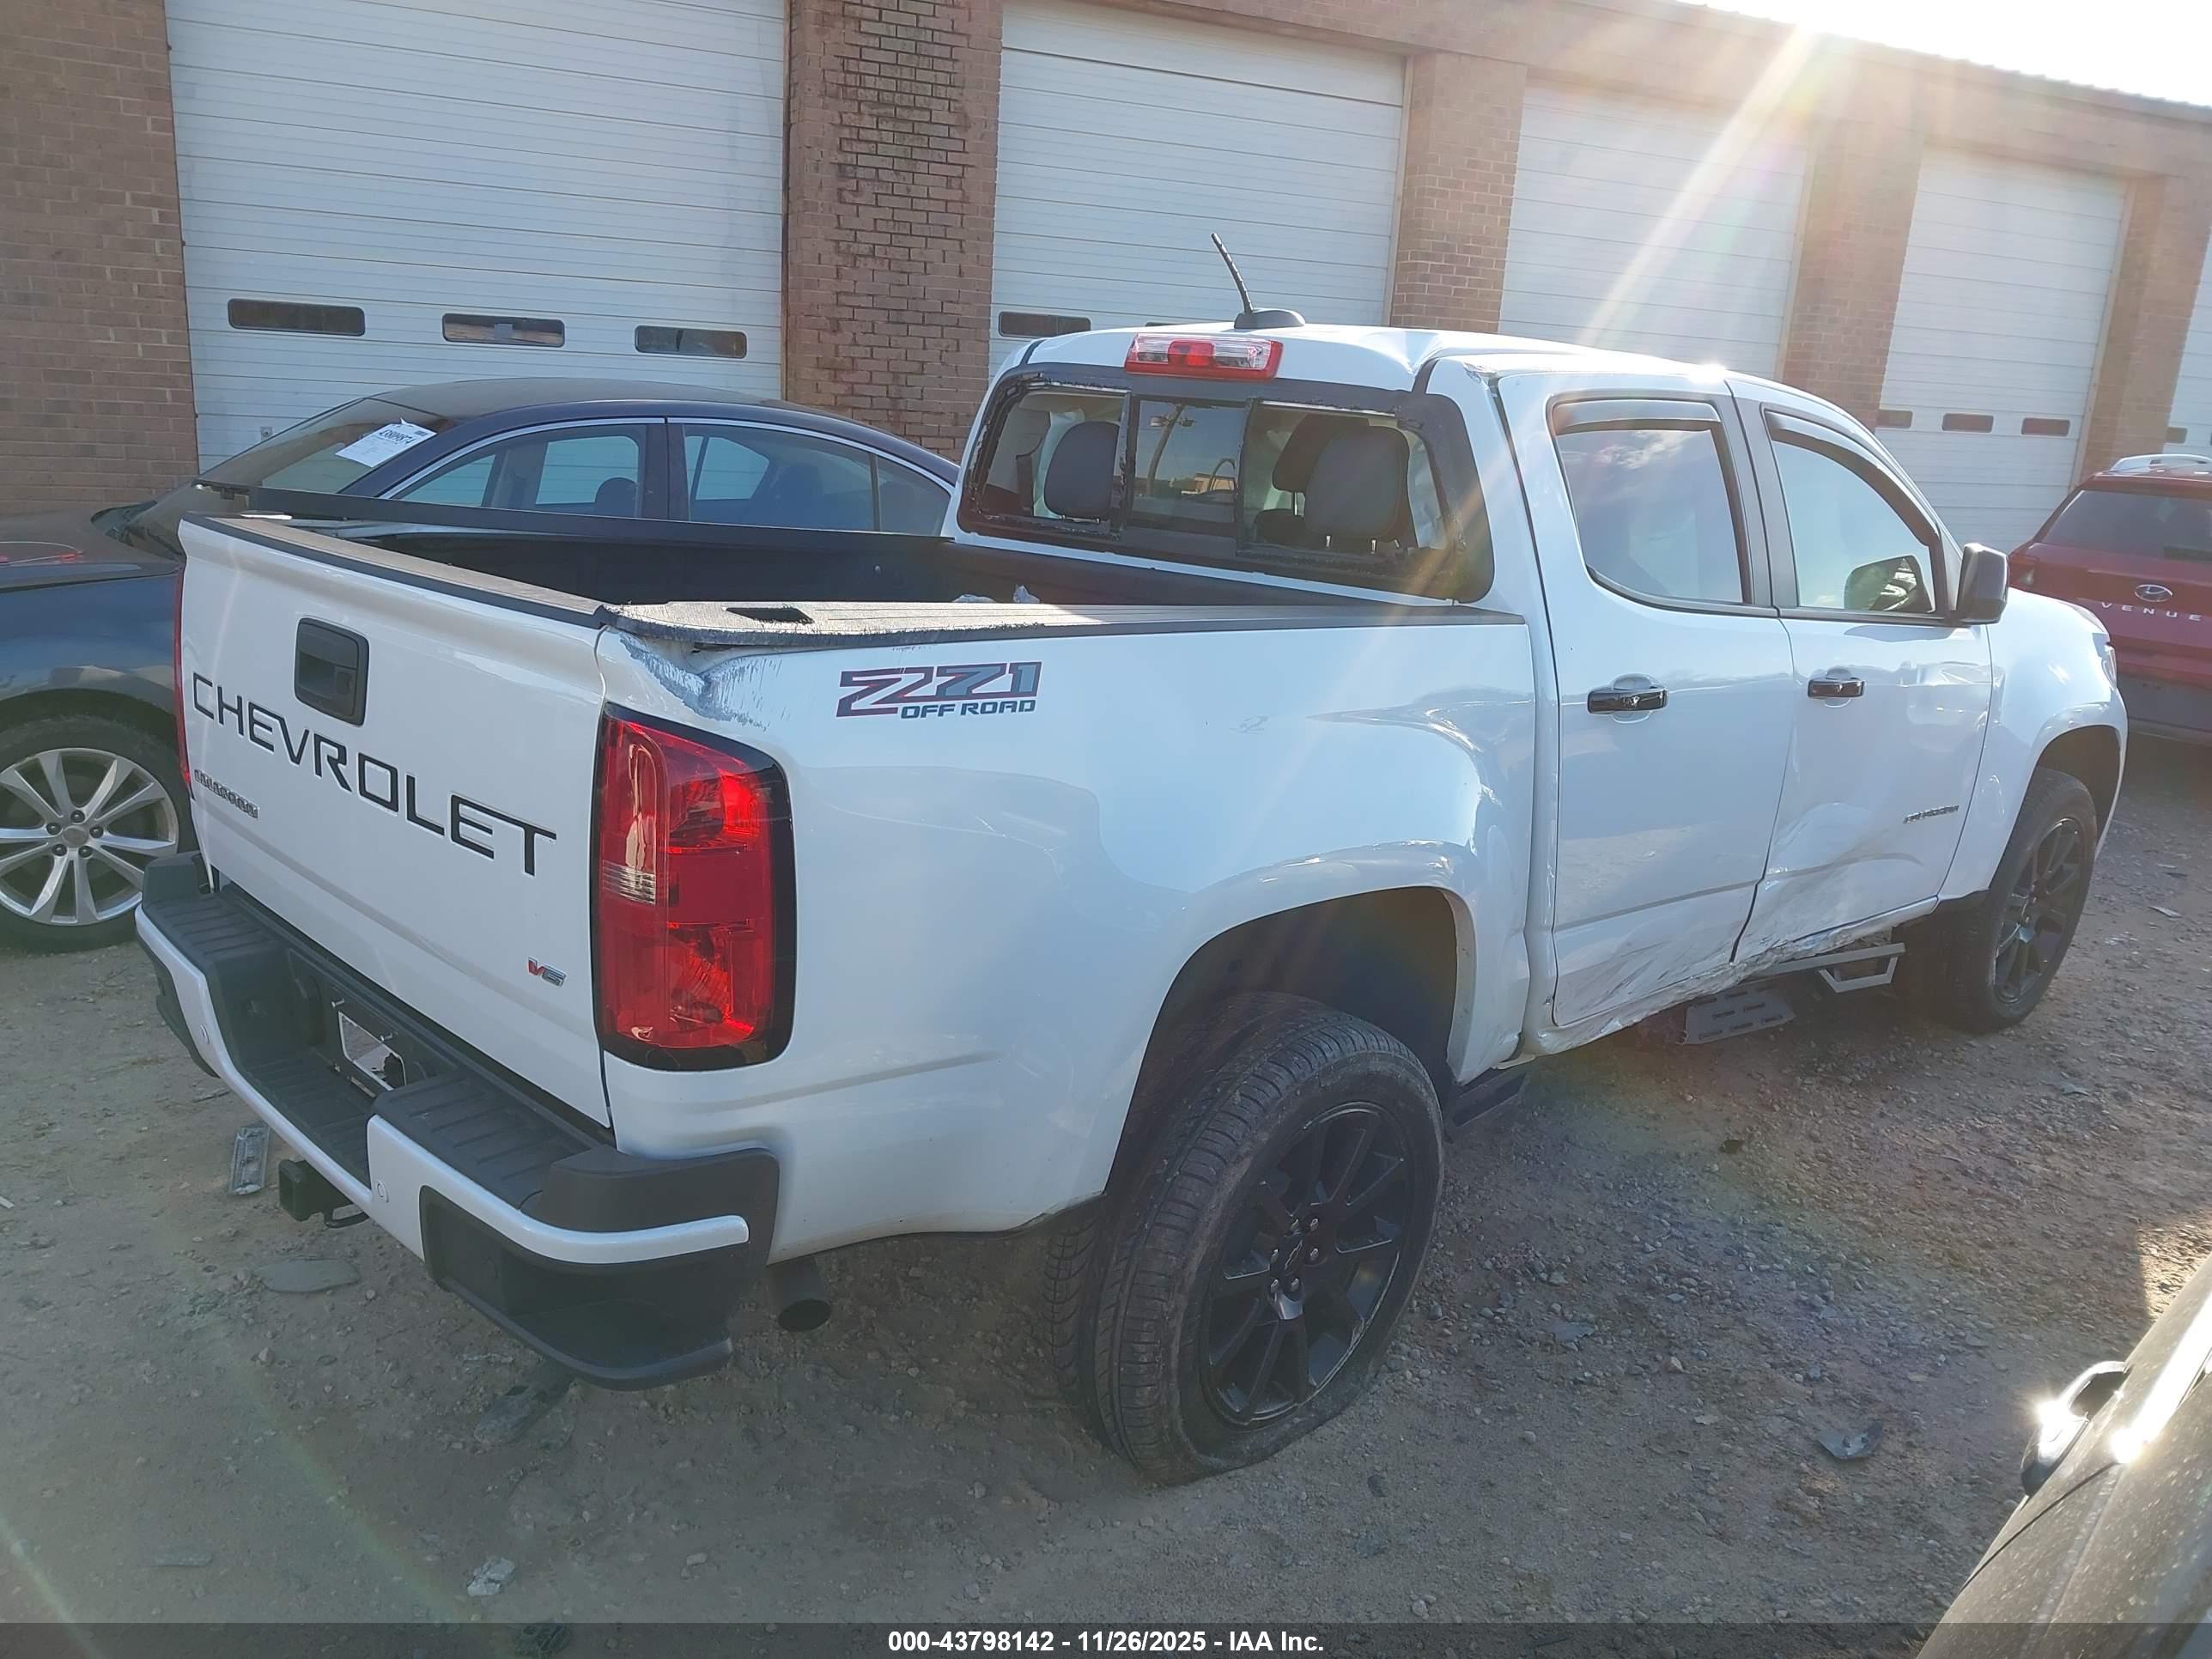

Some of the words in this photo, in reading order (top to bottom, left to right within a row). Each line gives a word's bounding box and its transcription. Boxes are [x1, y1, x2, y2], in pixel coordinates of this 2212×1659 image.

[2101, 602, 2202, 621] VENUE
[836, 661, 1042, 717] Z71
[901, 703, 955, 719] OFF
[960, 699, 1036, 716] ROAD
[193, 672, 556, 876] CHEVROLET
[528, 957, 566, 987] V6
